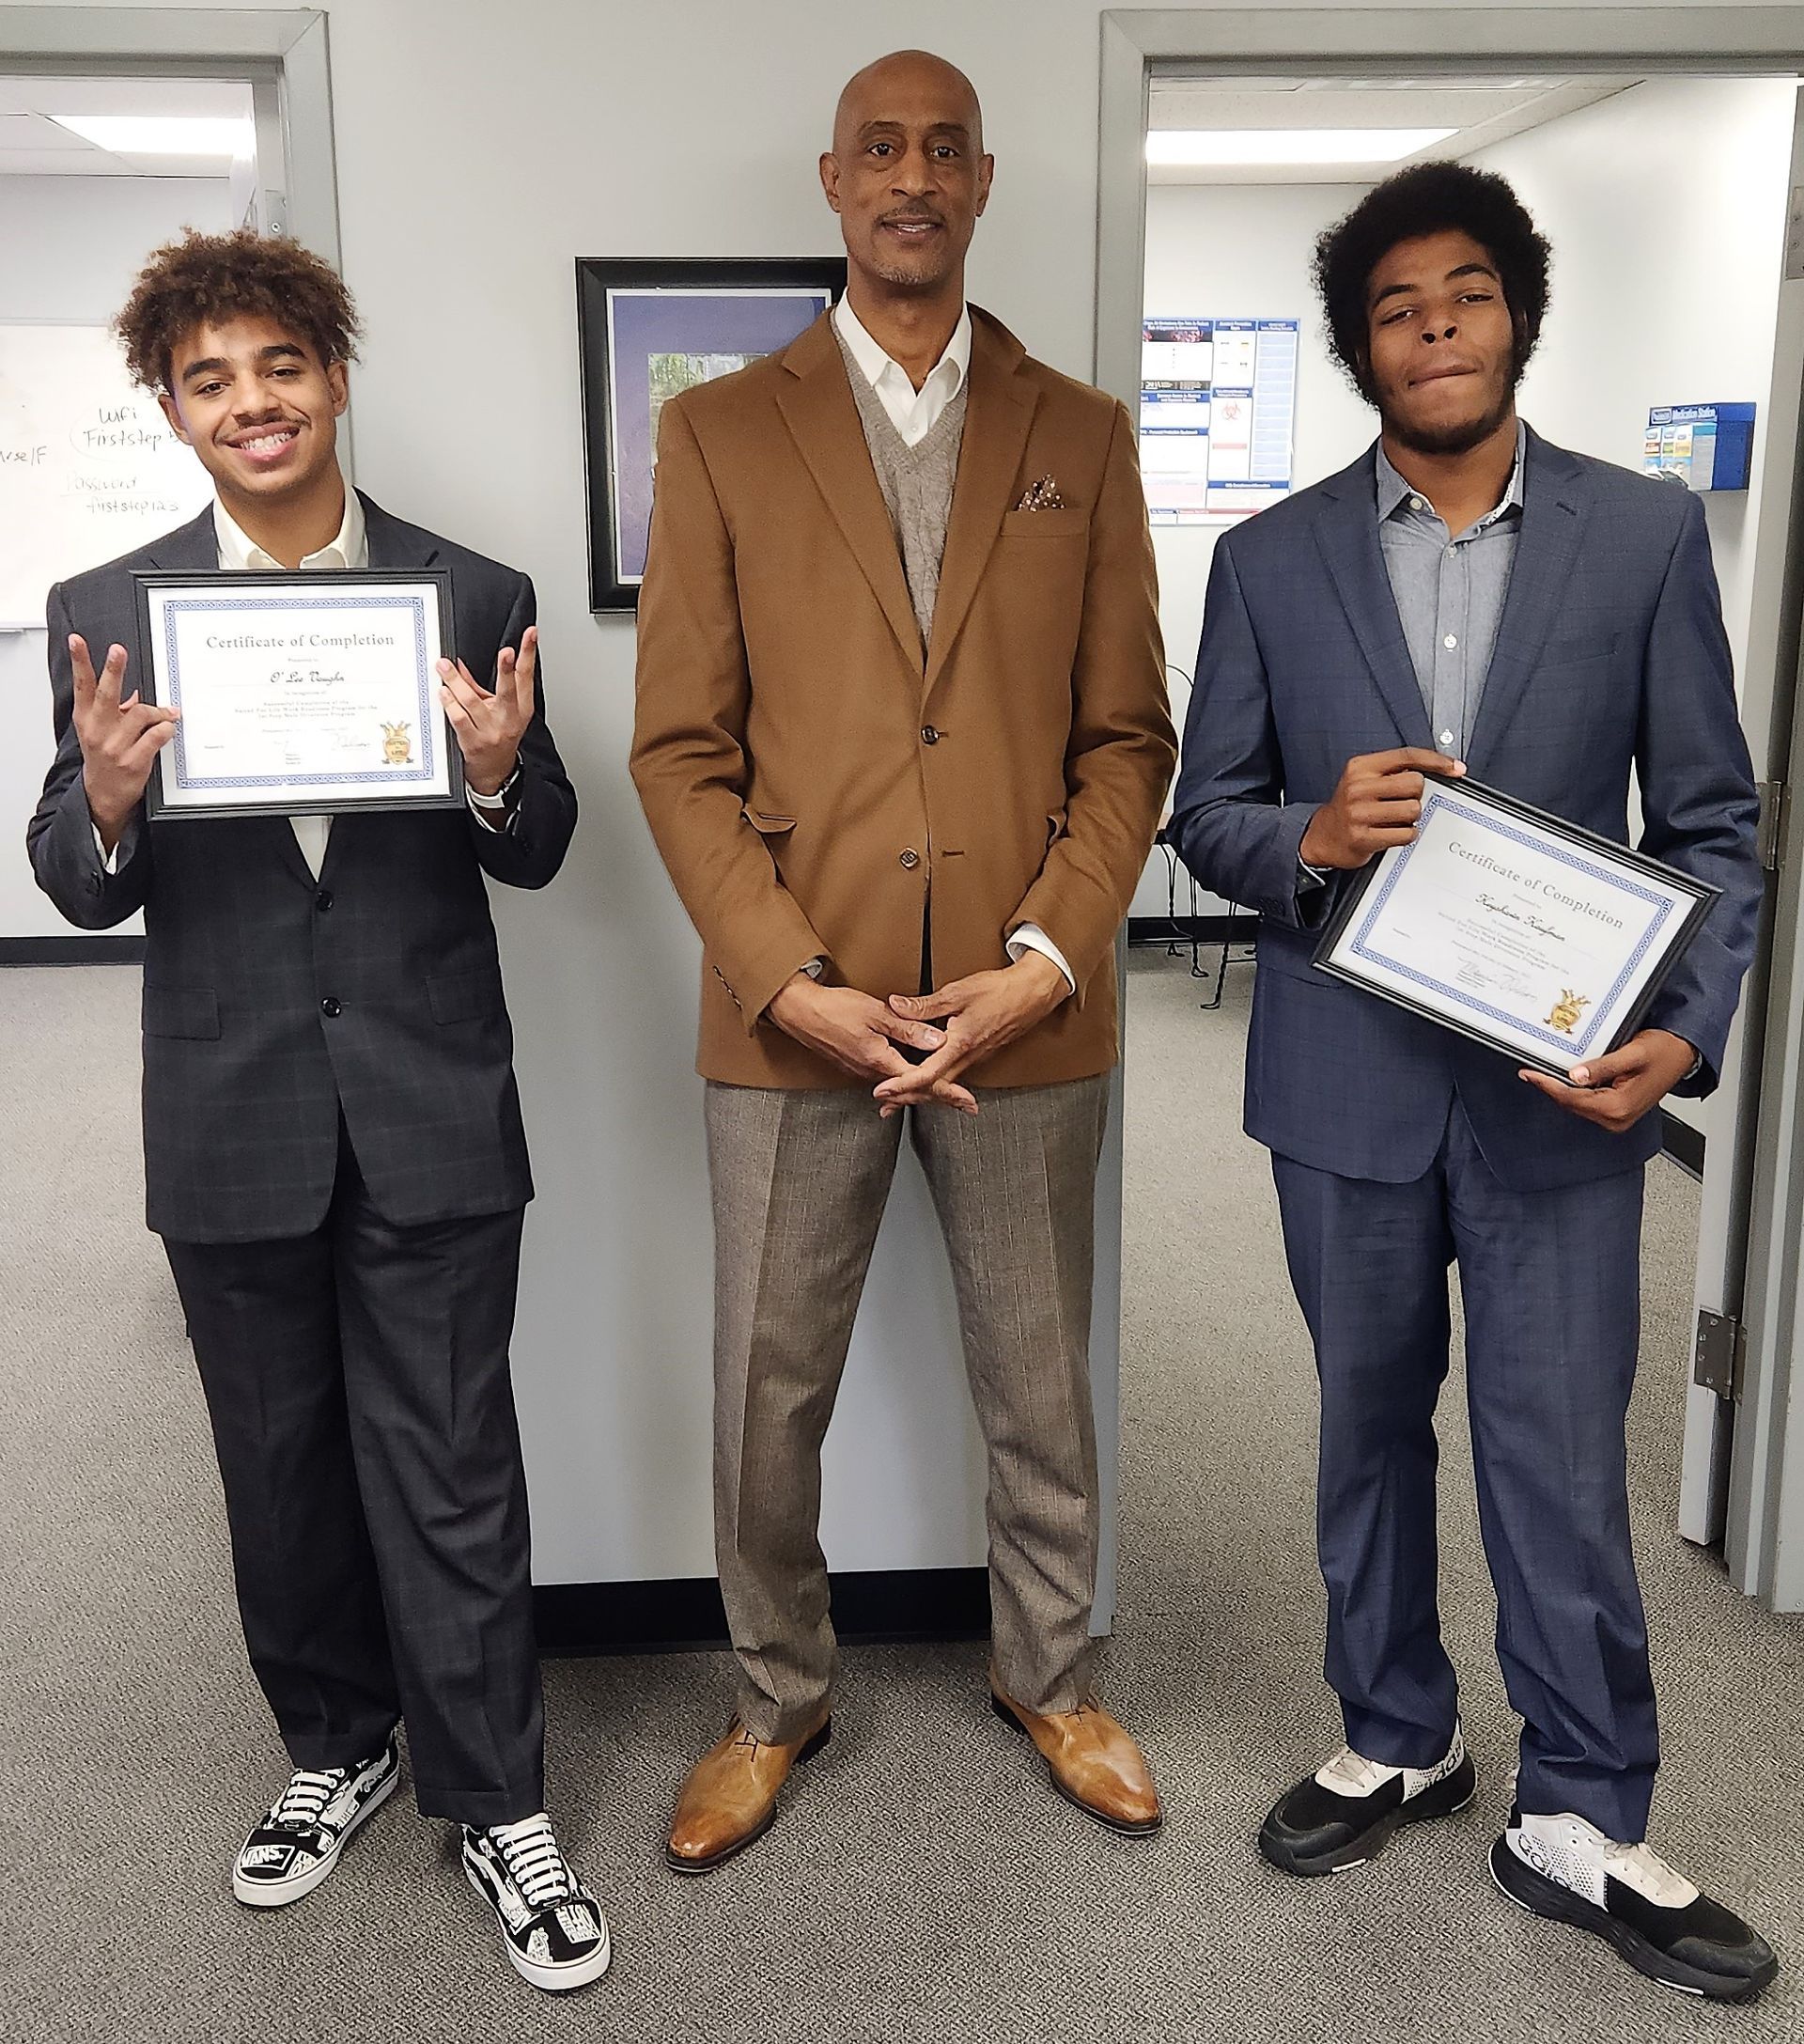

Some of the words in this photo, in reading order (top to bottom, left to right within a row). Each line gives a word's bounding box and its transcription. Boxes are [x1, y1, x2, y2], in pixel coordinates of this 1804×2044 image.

[206, 635, 285, 648] Certificate
[289, 634, 304, 647] of
[309, 633, 394, 649] Completion
[1448, 841, 1520, 882] Certificate
[1524, 879, 1542, 890] of
[1543, 884, 1624, 929] Completion
